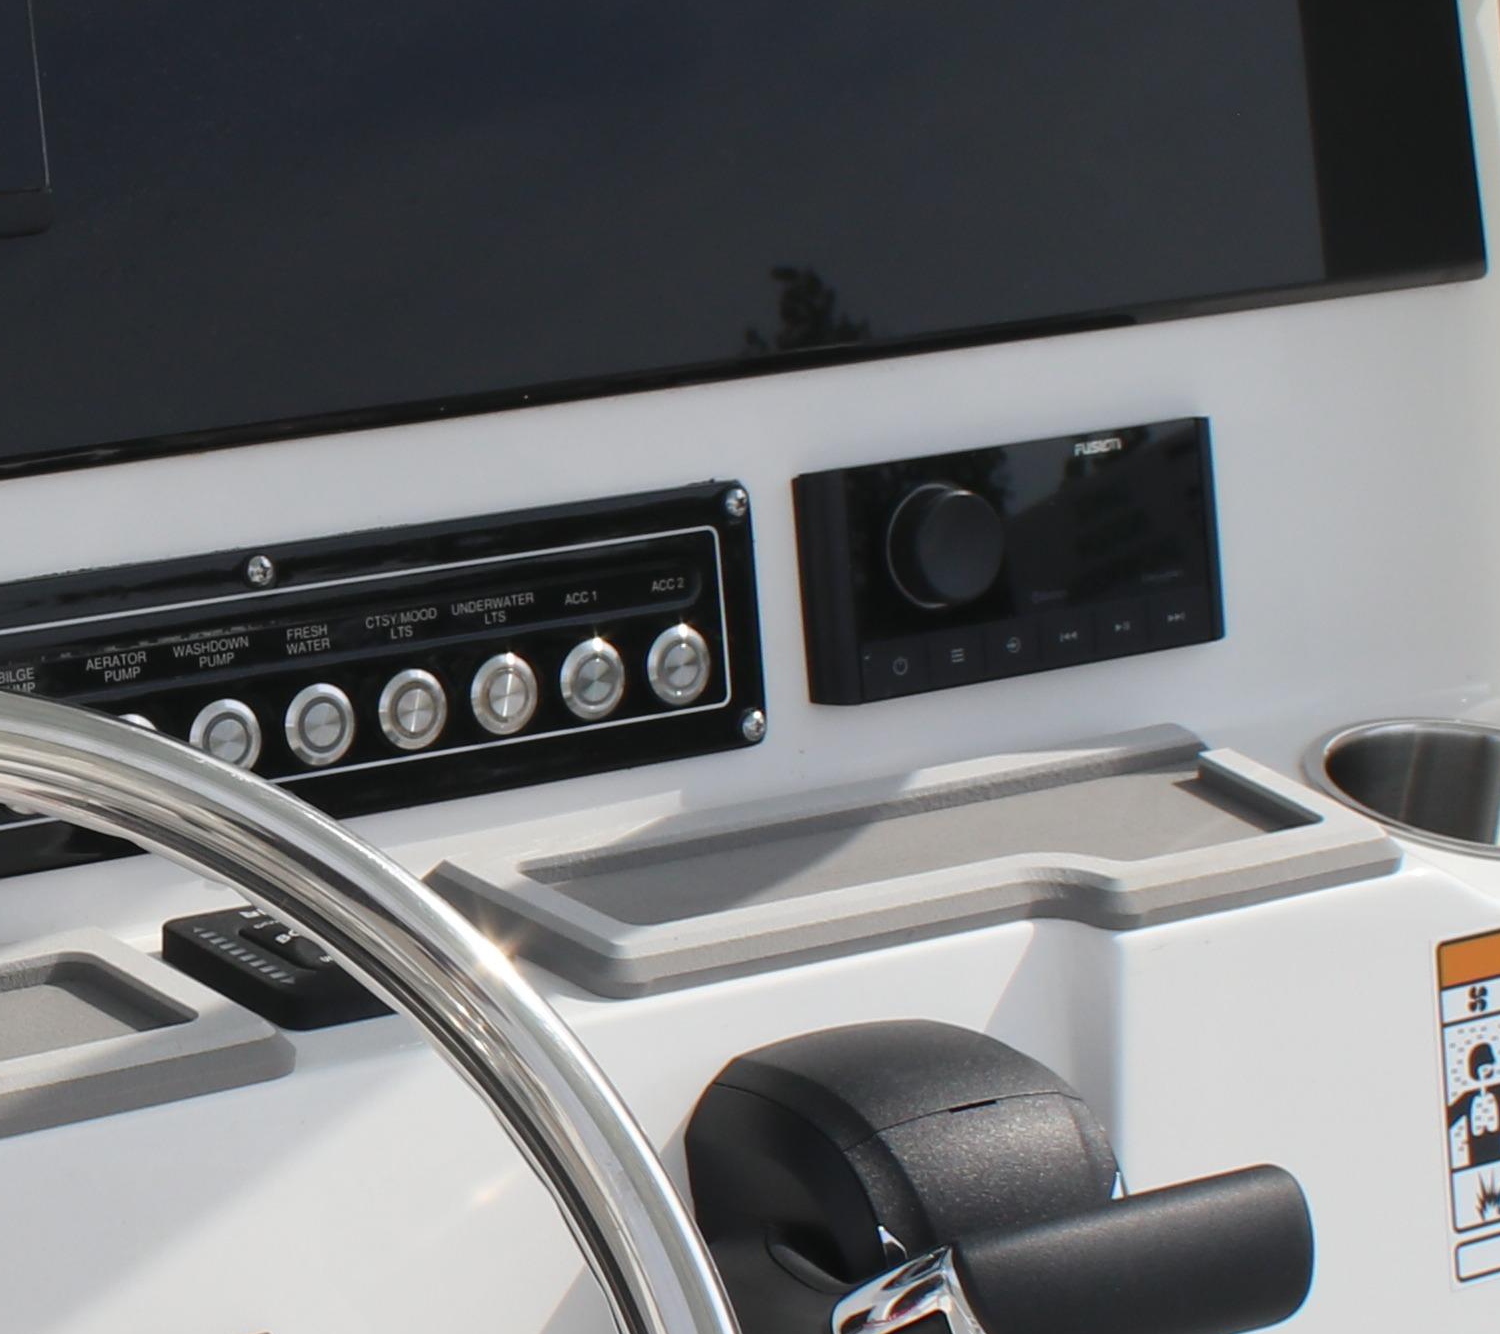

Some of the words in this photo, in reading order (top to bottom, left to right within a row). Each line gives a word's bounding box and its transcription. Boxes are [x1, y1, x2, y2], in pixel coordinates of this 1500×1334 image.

[1074, 437, 1121, 456] FUSION
[652, 578, 675, 592] ACC
[677, 577, 684, 588] 2
[451, 592, 534, 617] UNDERWATER
[565, 592, 589, 606] ACC
[592, 590, 597, 601] 1
[484, 611, 506, 625] LTS
[287, 624, 328, 641] FRESH
[390, 625, 414, 640] LTS
[172, 636, 249, 658] WASHDOWN
[286, 638, 331, 655] WATER
[86, 651, 147, 671] AERATOR
[199, 652, 235, 667] PUMP
[104, 667, 141, 683] PUMP
